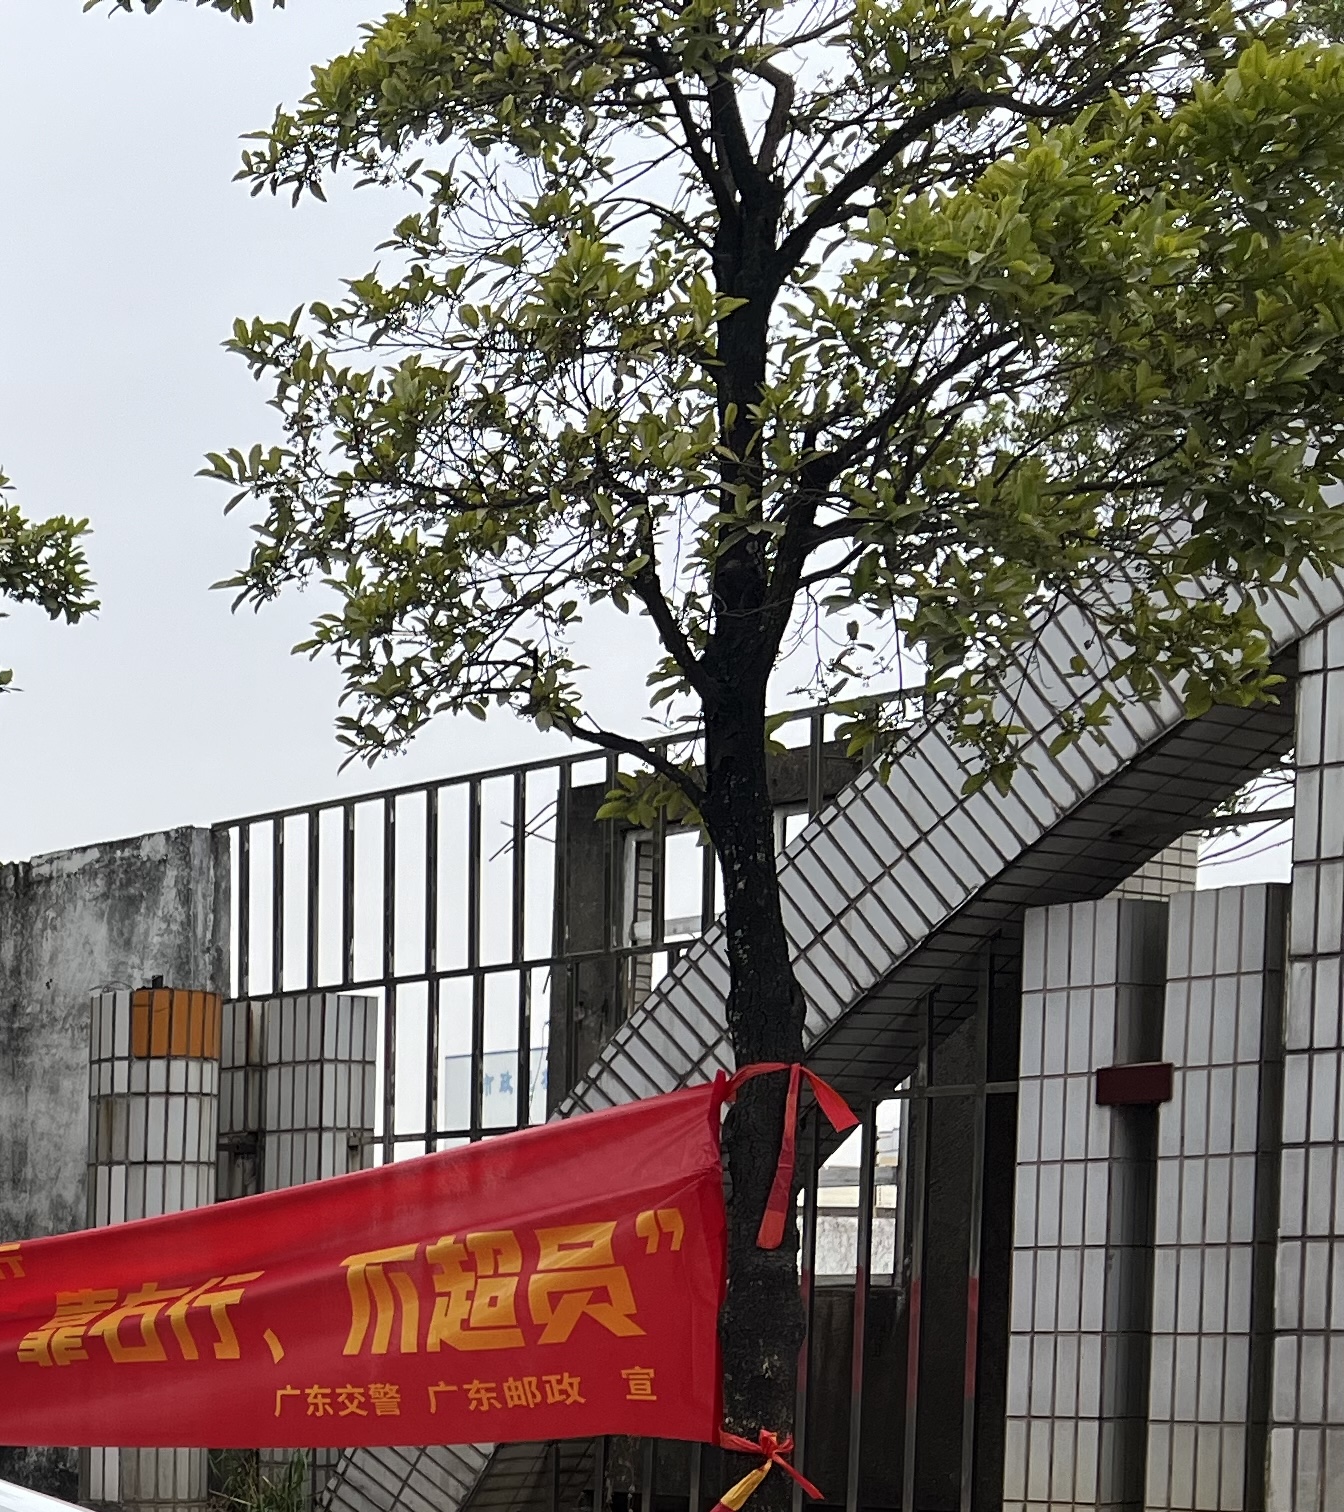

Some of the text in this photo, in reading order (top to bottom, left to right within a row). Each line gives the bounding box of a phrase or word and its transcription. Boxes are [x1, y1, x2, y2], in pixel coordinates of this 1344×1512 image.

[273, 1366, 658, 1418] 广东交警 广东邮政 宣
